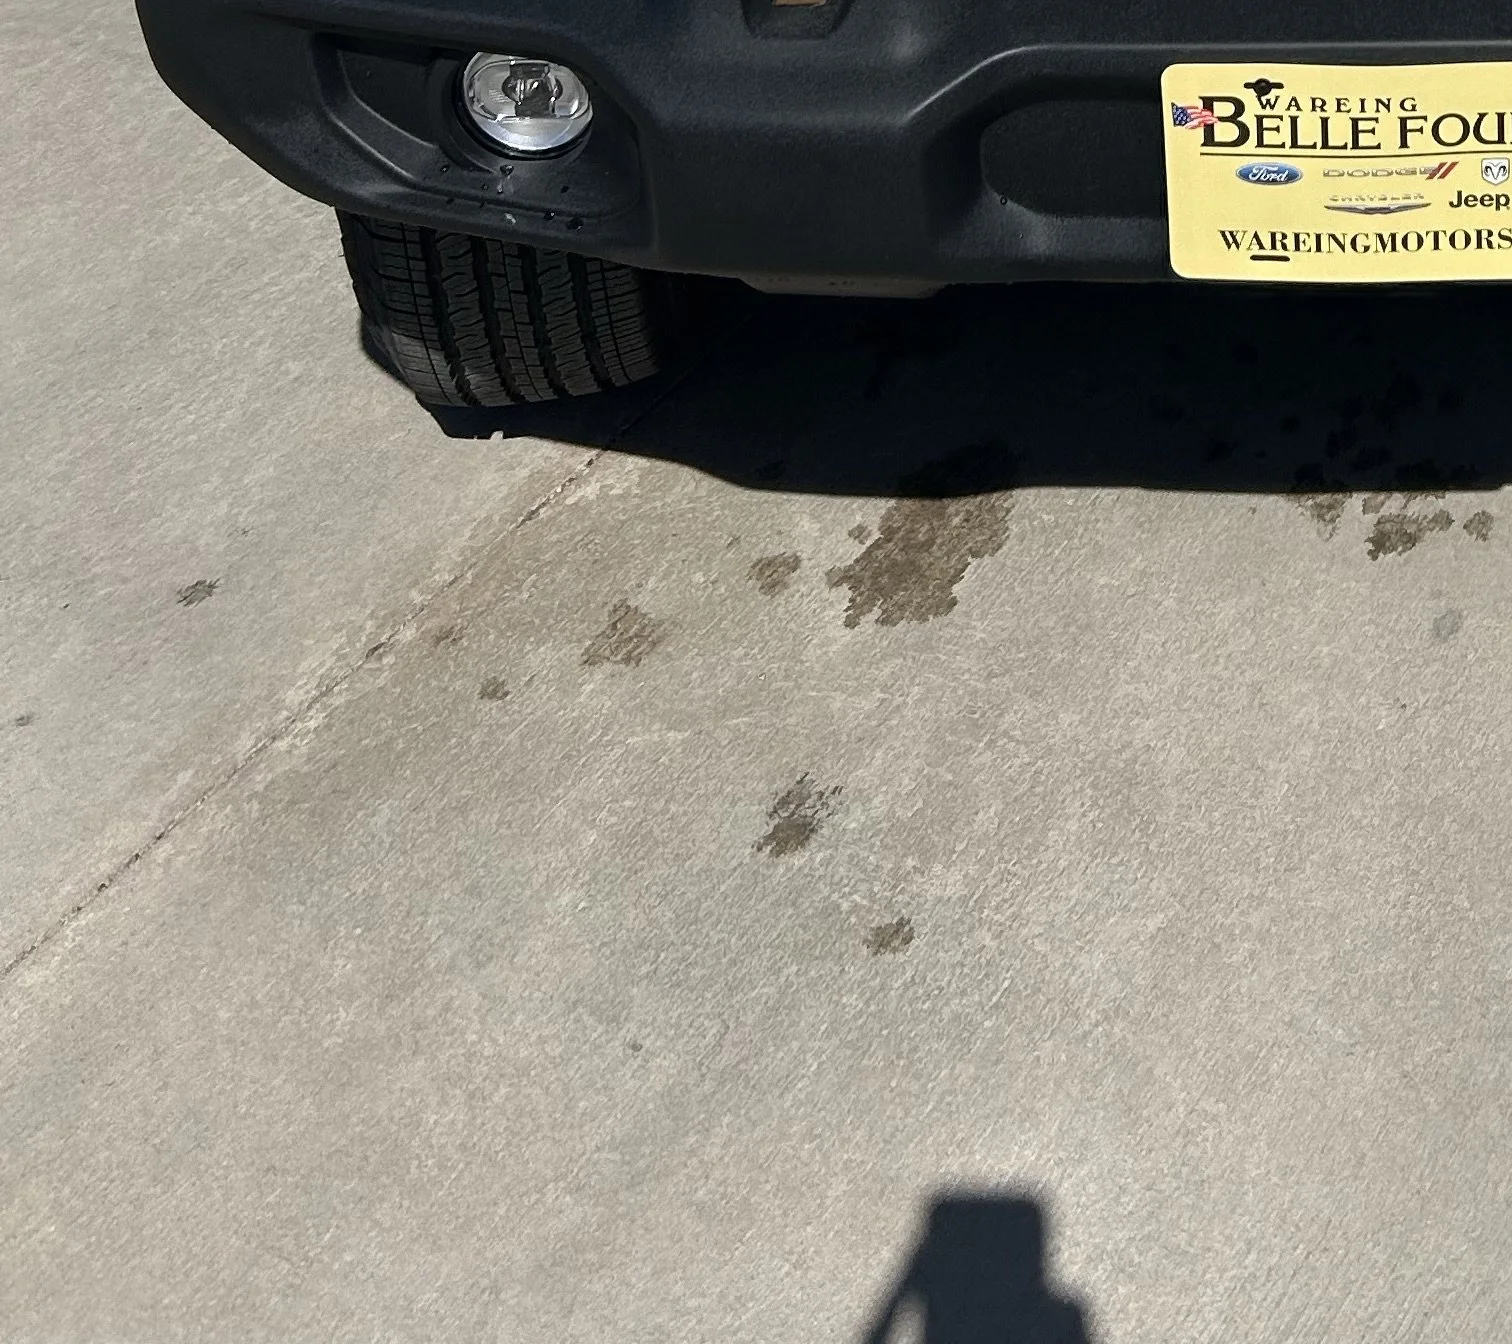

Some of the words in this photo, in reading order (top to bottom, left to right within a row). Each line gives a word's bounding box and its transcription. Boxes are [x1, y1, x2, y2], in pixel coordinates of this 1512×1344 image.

[1256, 95, 1418, 113] WAREING
[1198, 96, 1382, 150] BELLE
[1249, 165, 1289, 182] Ford
[1322, 166, 1437, 178] DODGE
[1448, 190, 1511, 211] Jeep
